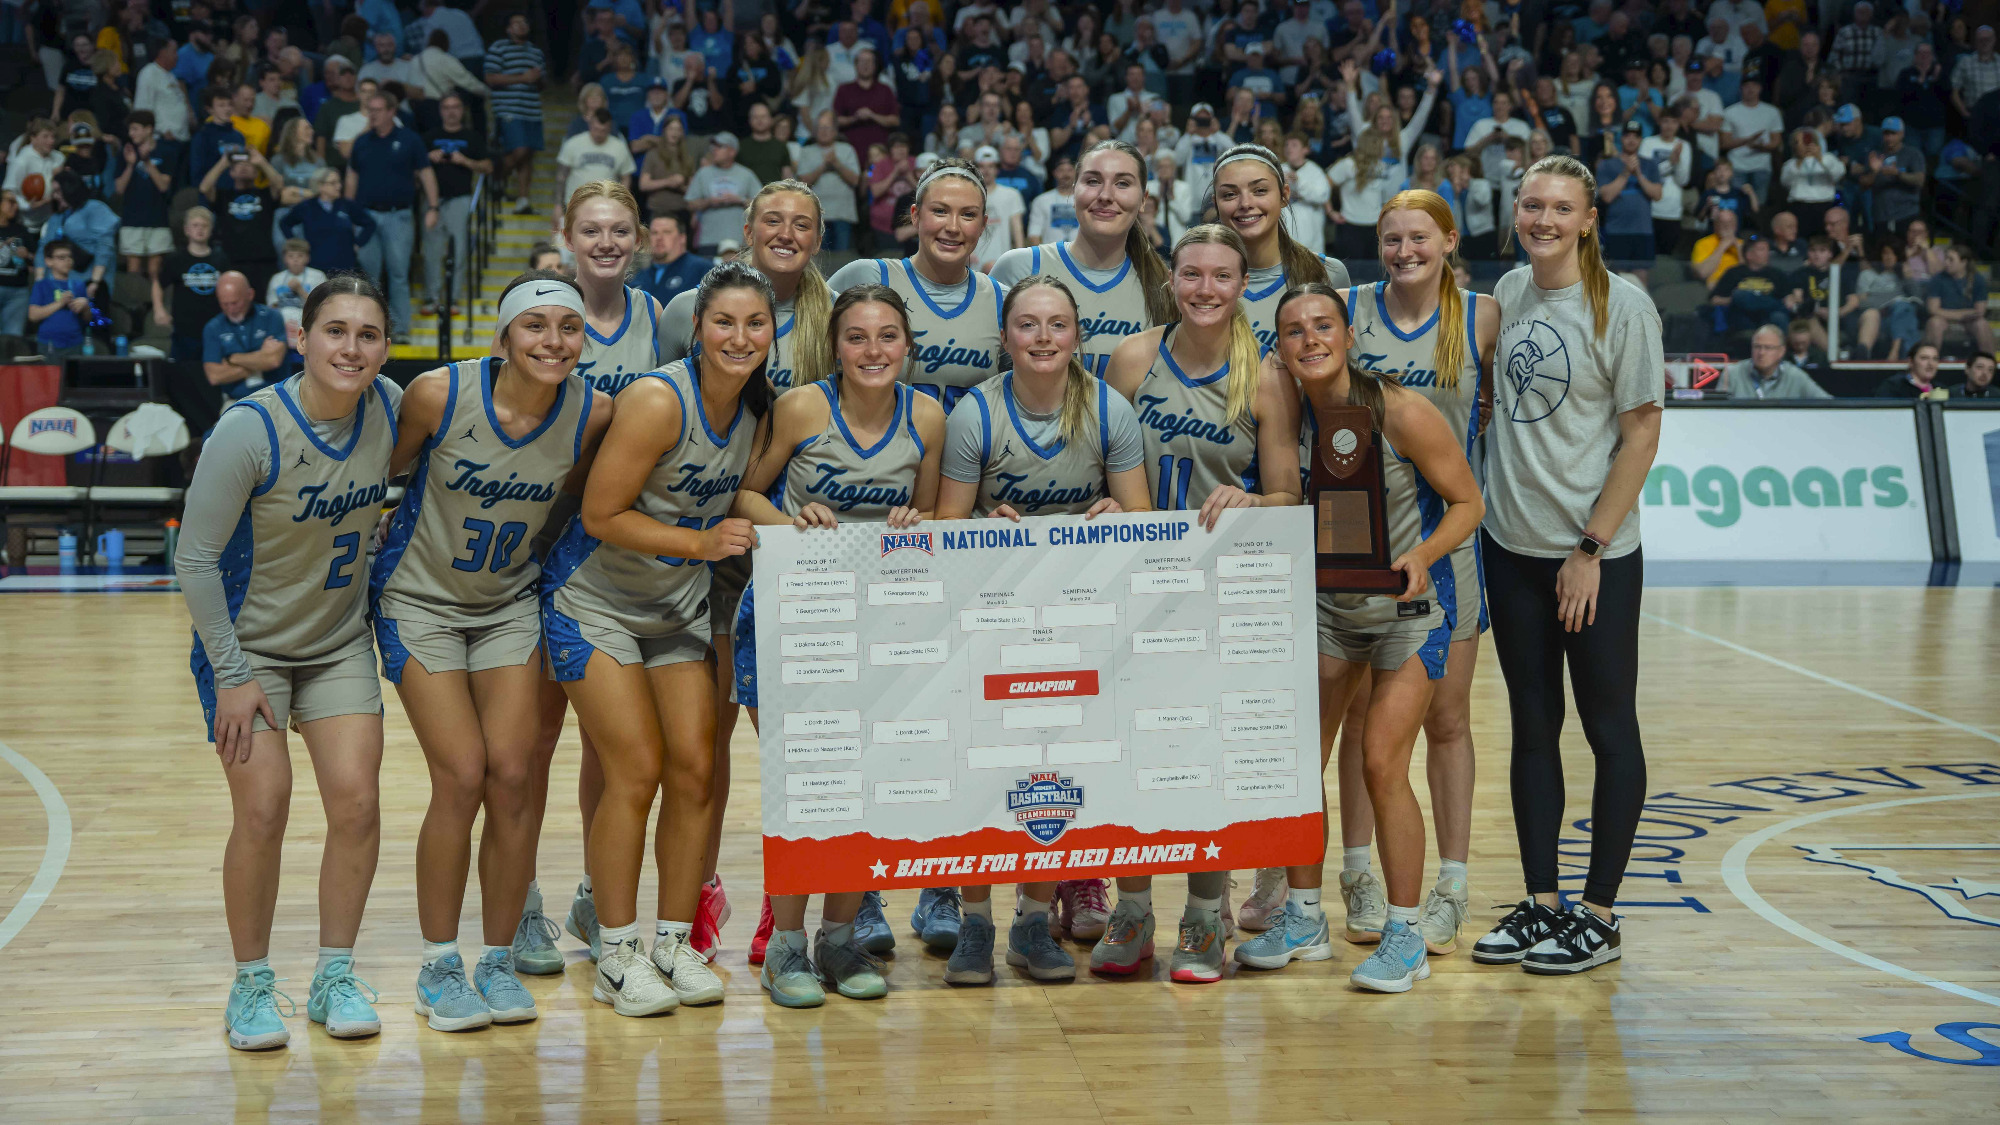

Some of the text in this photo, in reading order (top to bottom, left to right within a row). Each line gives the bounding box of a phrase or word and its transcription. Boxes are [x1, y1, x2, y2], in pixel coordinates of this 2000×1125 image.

[29, 418, 77, 438] NAIA
[1138, 395, 1234, 446] Trojans
[293, 478, 387, 526] Trojans
[446, 459, 556, 510] Trojans
[667, 463, 740, 507] Trojan
[806, 463, 910, 511] Trojans
[990, 472, 1095, 512] Trojans
[1157, 454, 1193, 510] 11
[451, 517, 528, 573] 30
[882, 522, 1190, 555] NAIA NATIONAL CHAMPIONSHIP
[323, 531, 360, 591] 2
[1009, 680, 1077, 694] CHAMPION
[1010, 789, 1081, 808] BASKETBALL
[1030, 773, 1058, 785] NAIA
[1018, 809, 1074, 820] CHAMPIONSHIP
[893, 843, 1197, 878] BATTLE FOR THE RED BANNER
